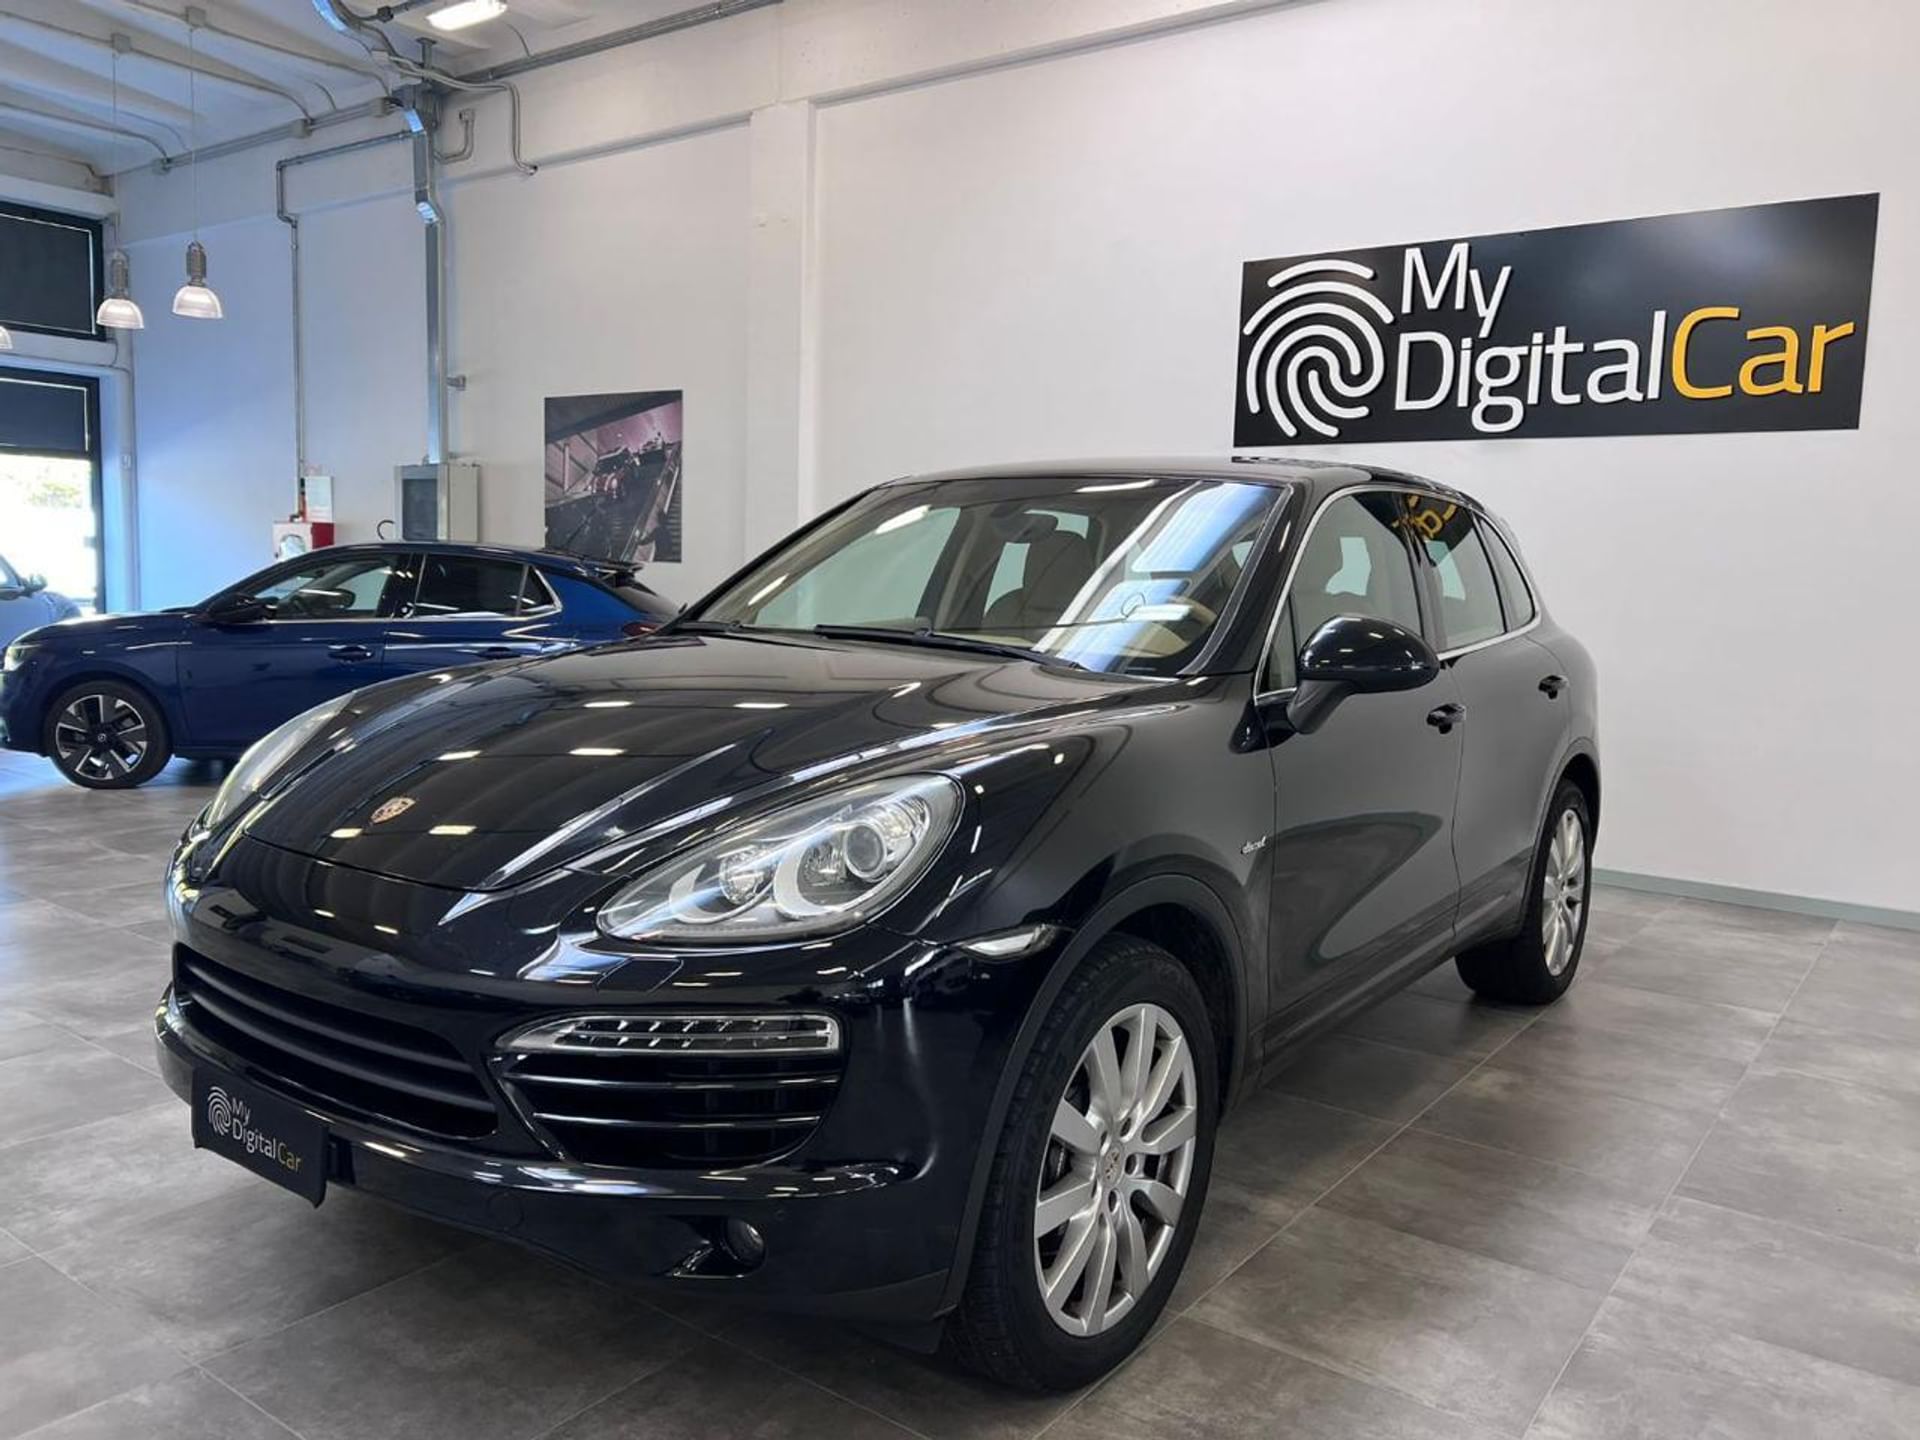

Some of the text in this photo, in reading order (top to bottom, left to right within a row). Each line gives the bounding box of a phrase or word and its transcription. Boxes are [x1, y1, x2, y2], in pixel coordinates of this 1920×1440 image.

[1402, 242, 1511, 338] My
[1395, 306, 1855, 432] DigitalCar
[231, 1098, 251, 1125] My
[232, 1118, 302, 1172] DigitalCar
